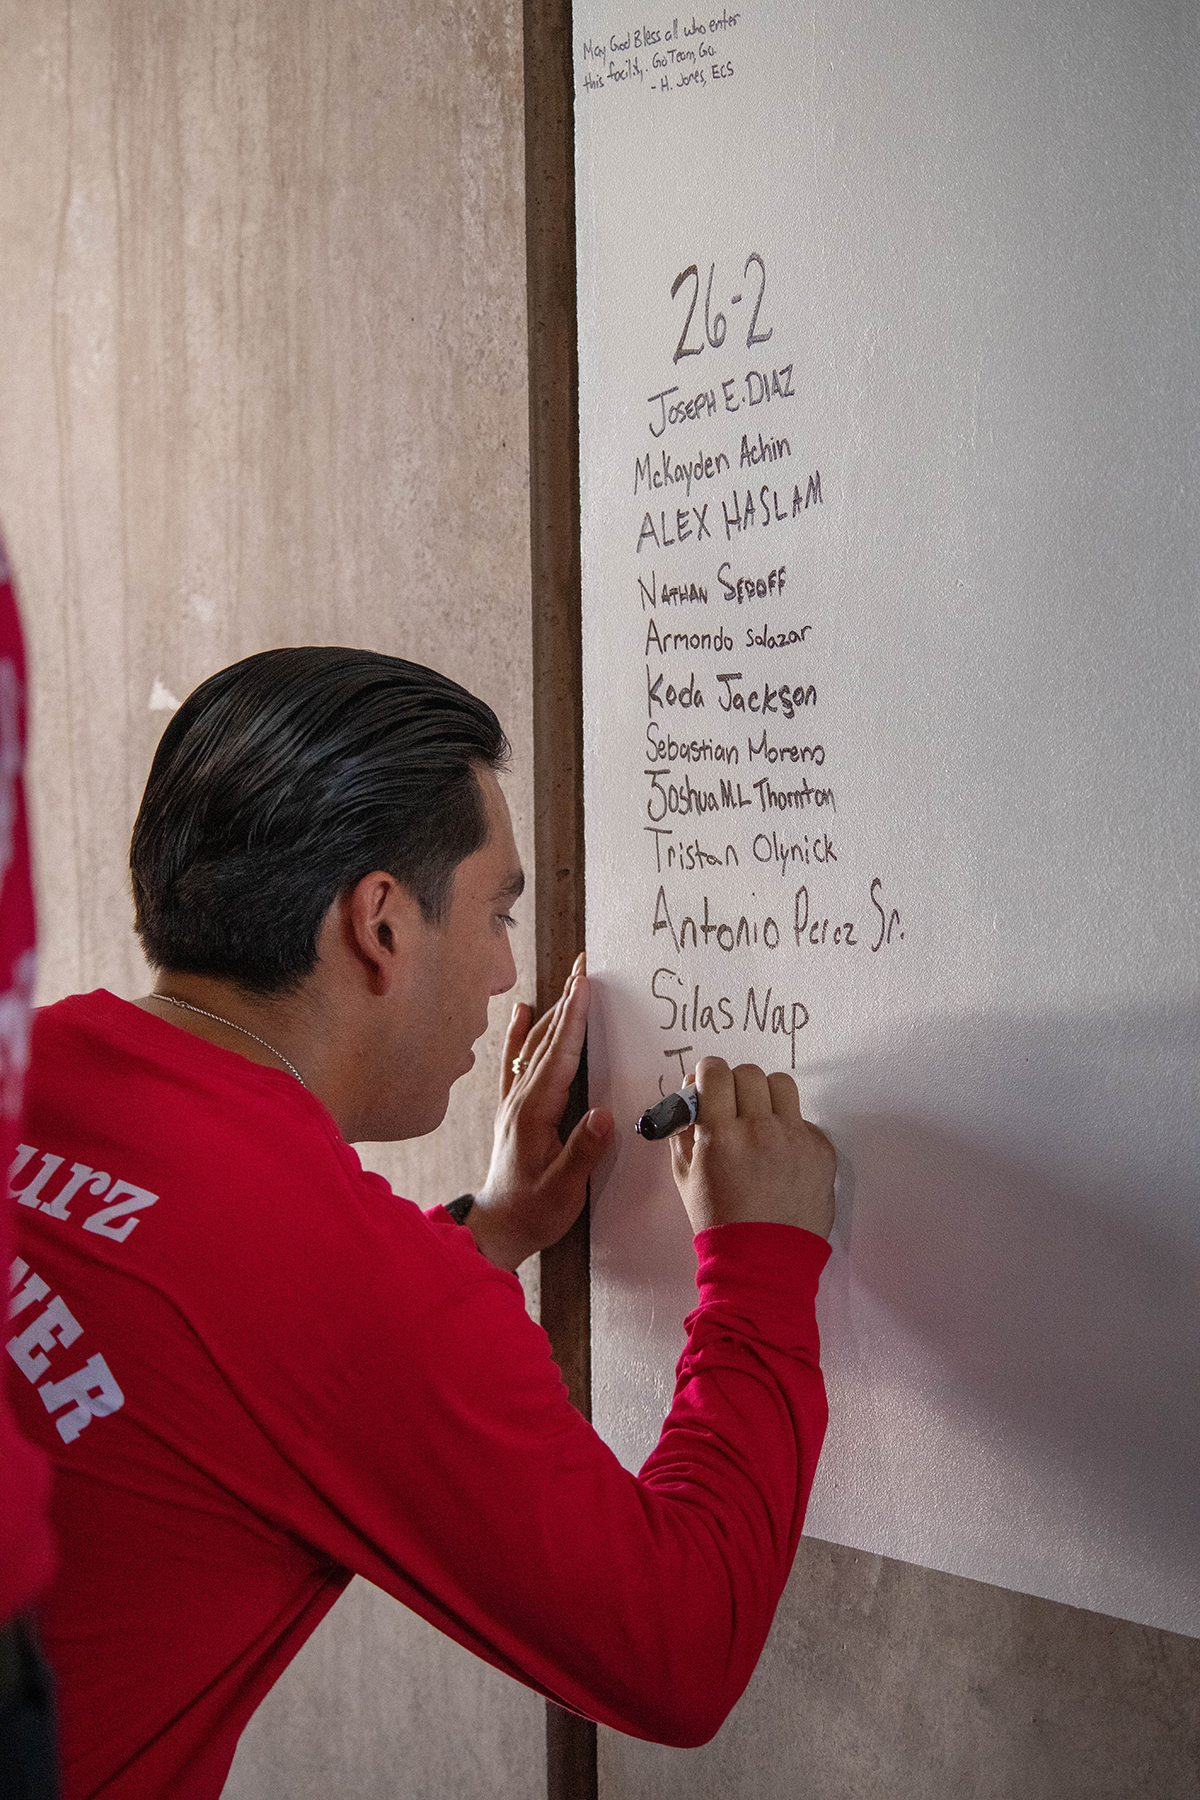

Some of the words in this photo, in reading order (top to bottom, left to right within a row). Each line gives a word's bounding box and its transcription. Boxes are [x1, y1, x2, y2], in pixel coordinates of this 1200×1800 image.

[583, 39, 606, 66] May
[610, 32, 631, 52] God
[634, 25, 661, 48] Bless
[665, 18, 678, 41] all
[684, 17, 706, 36] who
[708, 9, 740, 31] enter
[583, 73, 604, 93] this
[712, 61, 734, 79] ECS
[671, 252, 773, 365] 26-2
[634, 449, 729, 497] McKayden
[740, 433, 791, 468] Achin
[636, 503, 711, 553] ALEX
[722, 470, 823, 541] HASLAM
[645, 618, 733, 656] Armondo
[646, 664, 704, 718] Koda
[716, 672, 817, 719] Jackson
[646, 722, 739, 764] Sebastian
[748, 729, 825, 765] Moreno
[644, 826, 739, 873] Tristan
[753, 831, 837, 876] Olynick
[653, 885, 780, 953] Antonio
[793, 885, 858, 947] Perez
[871, 877, 904, 952] Sr.
[652, 968, 734, 1034] Silas
[743, 987, 809, 1069] Nap
